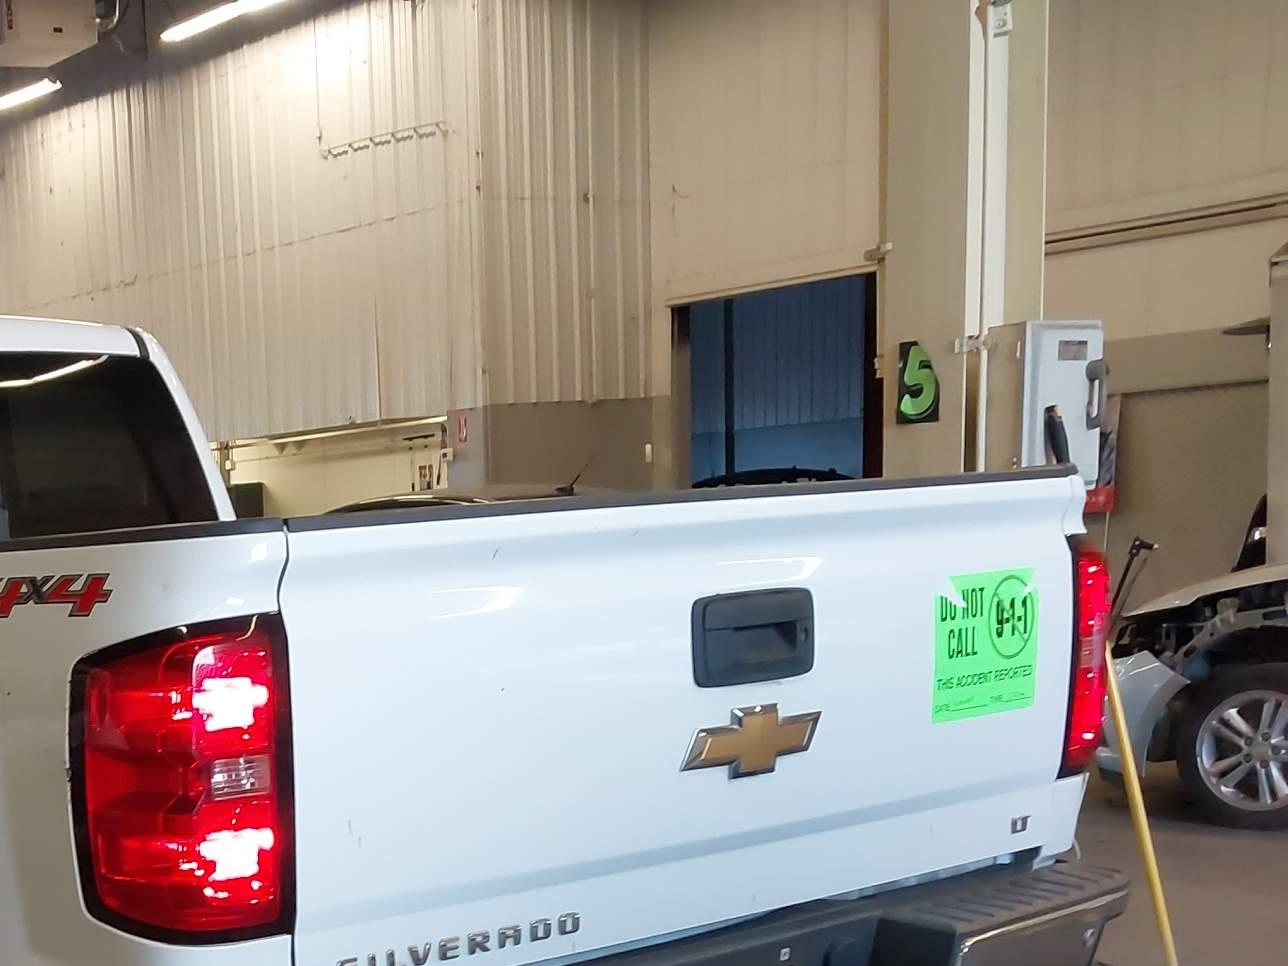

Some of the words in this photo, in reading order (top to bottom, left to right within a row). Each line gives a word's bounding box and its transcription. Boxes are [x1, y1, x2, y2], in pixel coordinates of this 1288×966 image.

[899, 344, 937, 419] 5
[939, 595, 957, 622] DO
[961, 586, 985, 620] NOT
[947, 626, 979, 659] CALL
[955, 670, 993, 688] ACCIDENT
[1010, 814, 1032, 835] LT
